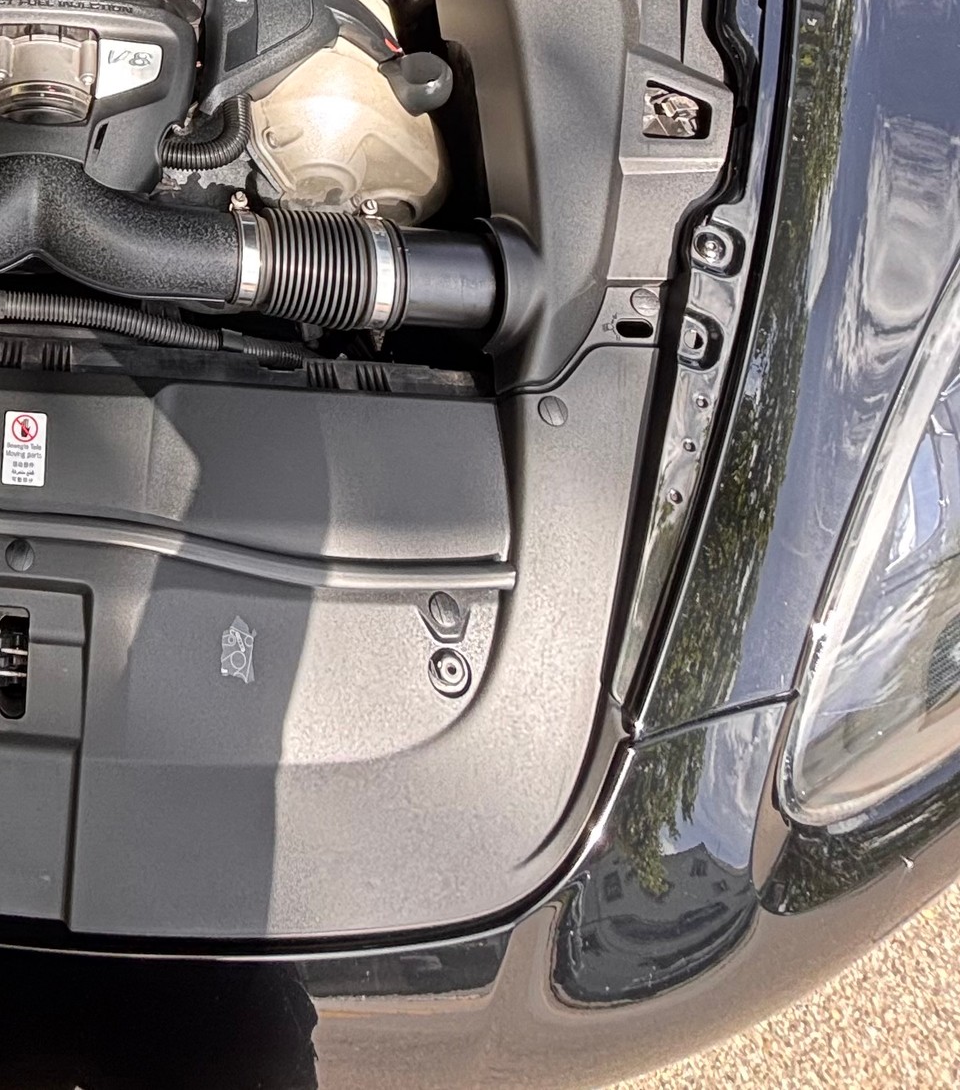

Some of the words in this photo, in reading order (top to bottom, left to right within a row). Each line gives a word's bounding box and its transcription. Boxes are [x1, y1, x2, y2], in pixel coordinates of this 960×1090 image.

[58, 0, 134, 14] INJECTION
[107, 49, 154, 67] V8
[5, 450, 26, 459] Moving
